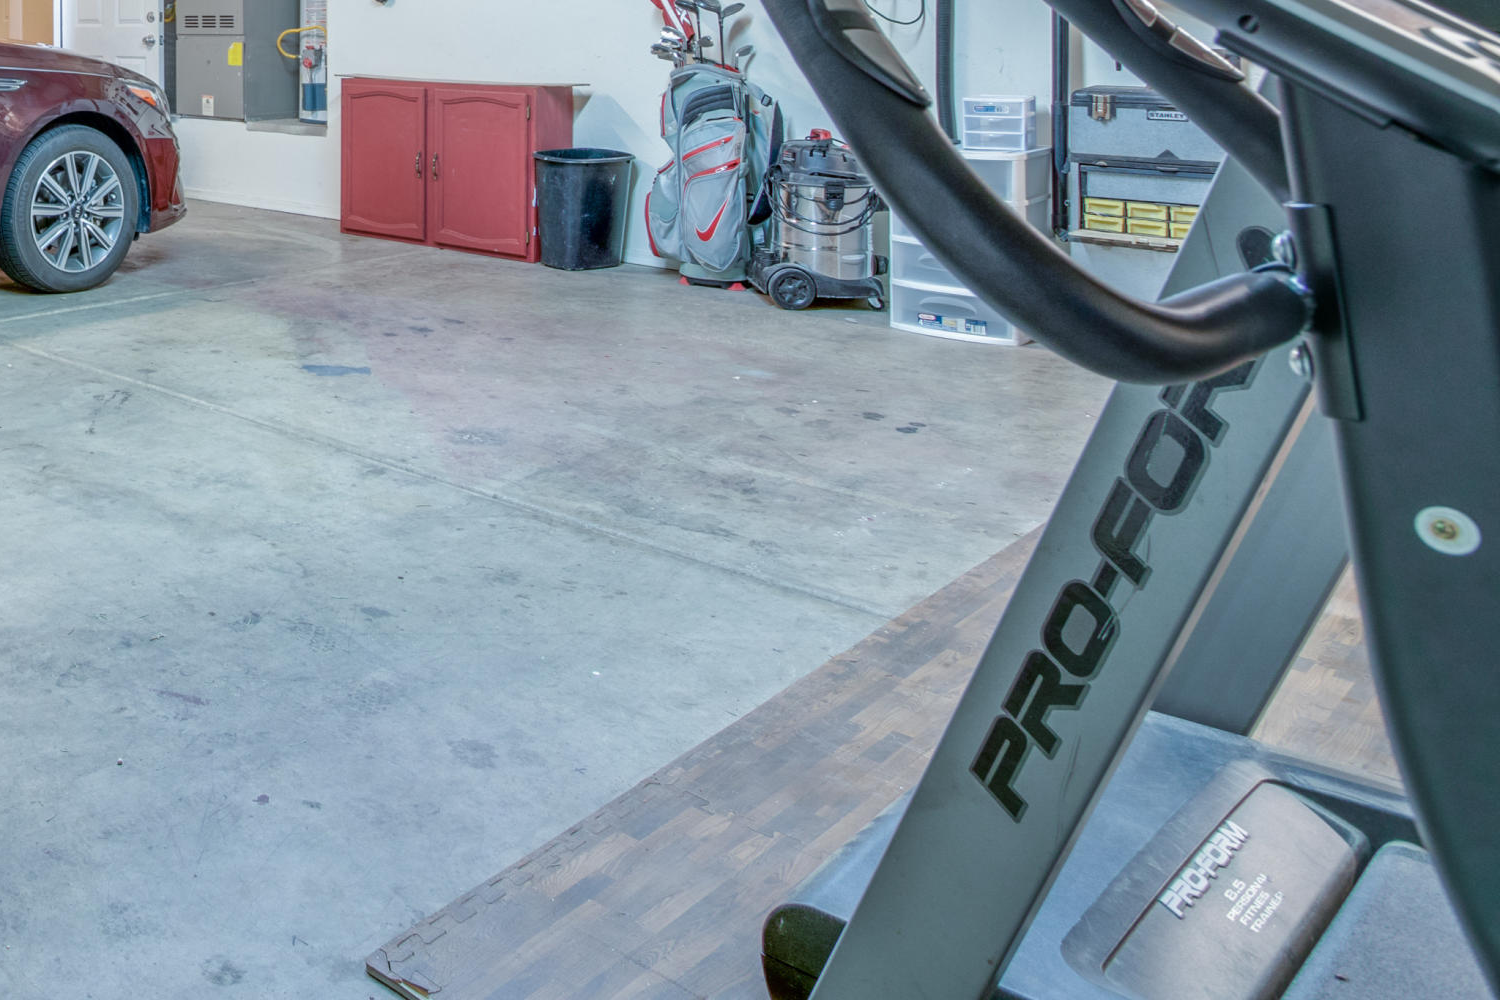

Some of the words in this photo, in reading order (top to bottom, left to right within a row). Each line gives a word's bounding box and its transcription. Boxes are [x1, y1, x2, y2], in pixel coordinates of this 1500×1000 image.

[969, 352, 1267, 824] PRO-FOR
[1158, 819, 1251, 920] PRO-FORM
[1223, 878, 1247, 902] 8.5
